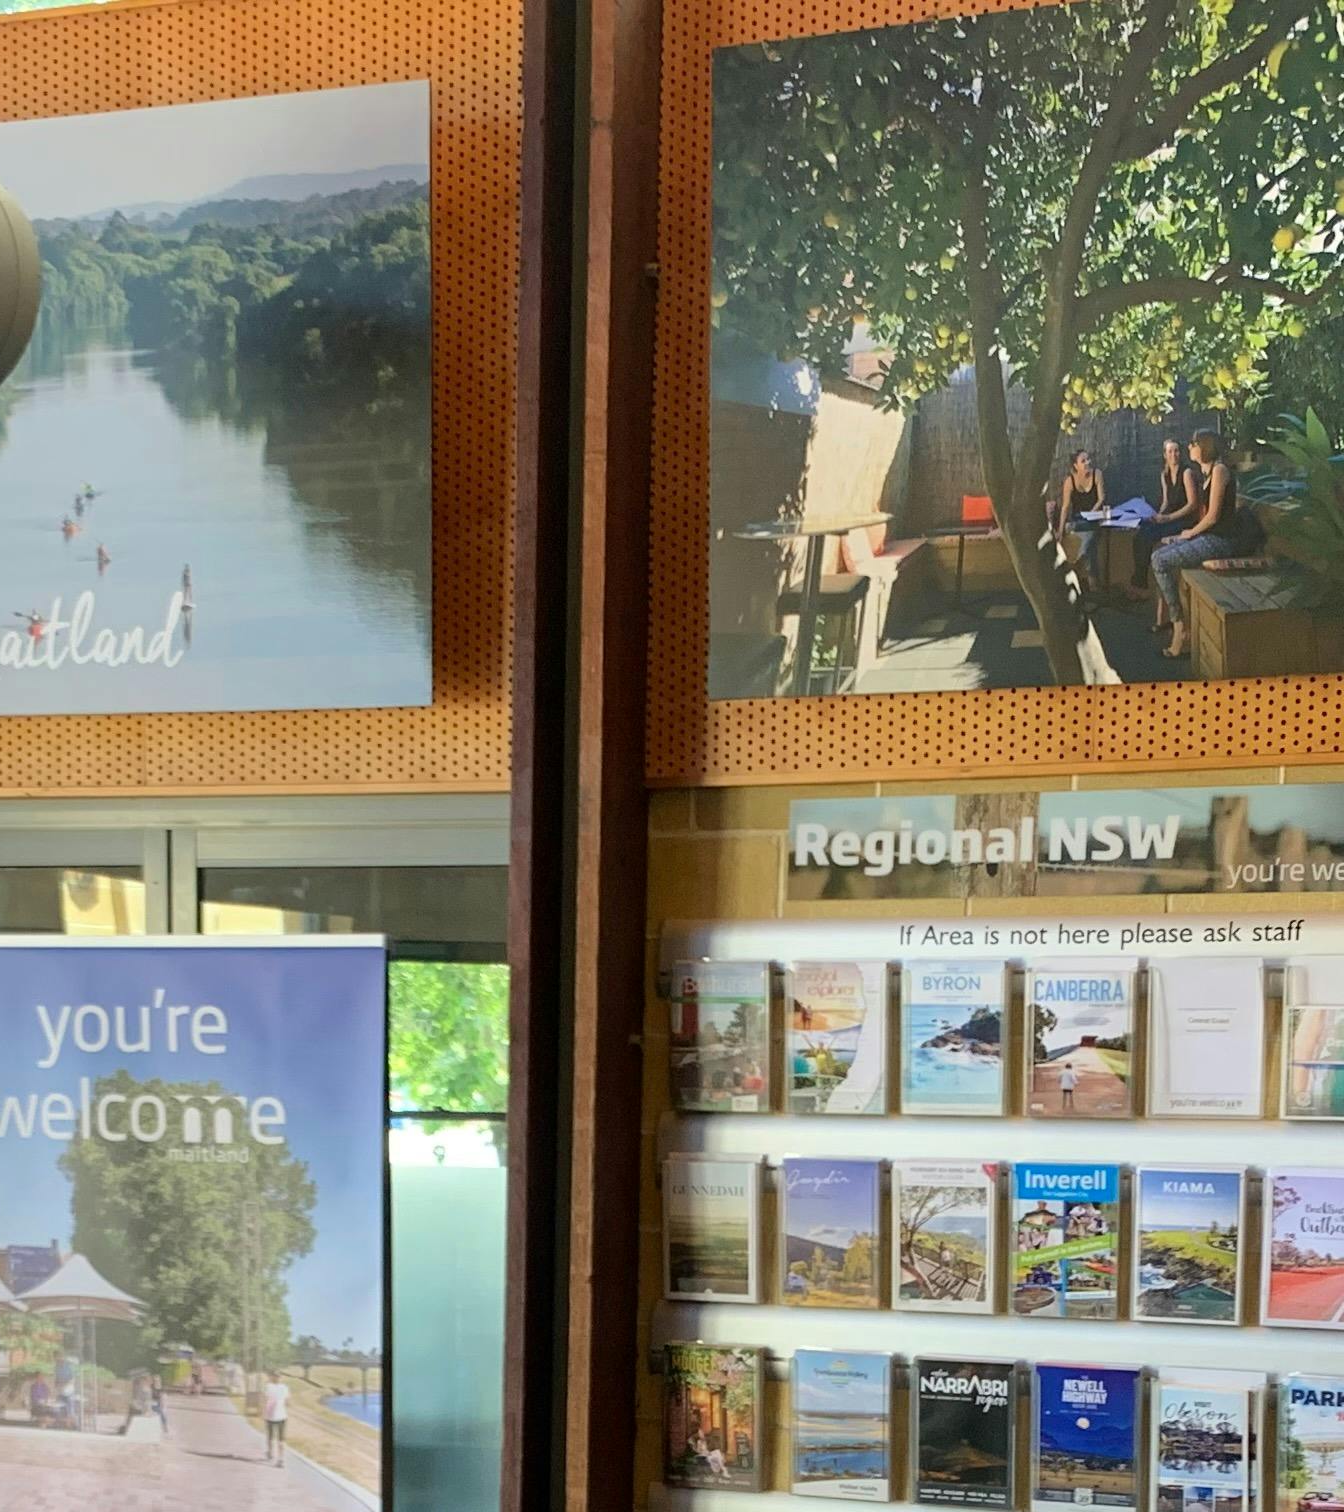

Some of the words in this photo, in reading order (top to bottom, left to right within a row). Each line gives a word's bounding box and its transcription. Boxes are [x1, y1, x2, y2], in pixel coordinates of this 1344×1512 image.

[794, 815, 1033, 877] Regional
[1048, 814, 1181, 862] NSW
[1227, 856, 1306, 888] you're
[899, 925, 916, 946] If
[921, 925, 974, 946] Area
[984, 924, 1000, 945] is
[1010, 926, 1048, 945] not
[1059, 923, 1110, 945] here
[1120, 922, 1194, 950] please
[1203, 921, 1242, 942] ask
[1252, 919, 1305, 942] staff
[922, 974, 982, 992] BYRON
[1033, 979, 1125, 1002] CANBERRA
[36, 988, 228, 1069] you're
[167, 1144, 250, 1165] maitland
[671, 1183, 745, 1199] GUNNEDAH
[1024, 1170, 1107, 1191] Inverell
[1163, 1180, 1216, 1195] KIAMA
[920, 1374, 1009, 1397] NARRABRI
[1063, 1378, 1106, 1393] NEWELL
[1062, 1390, 1108, 1405] HIGHWAY
[1164, 1401, 1238, 1423] Oberon
